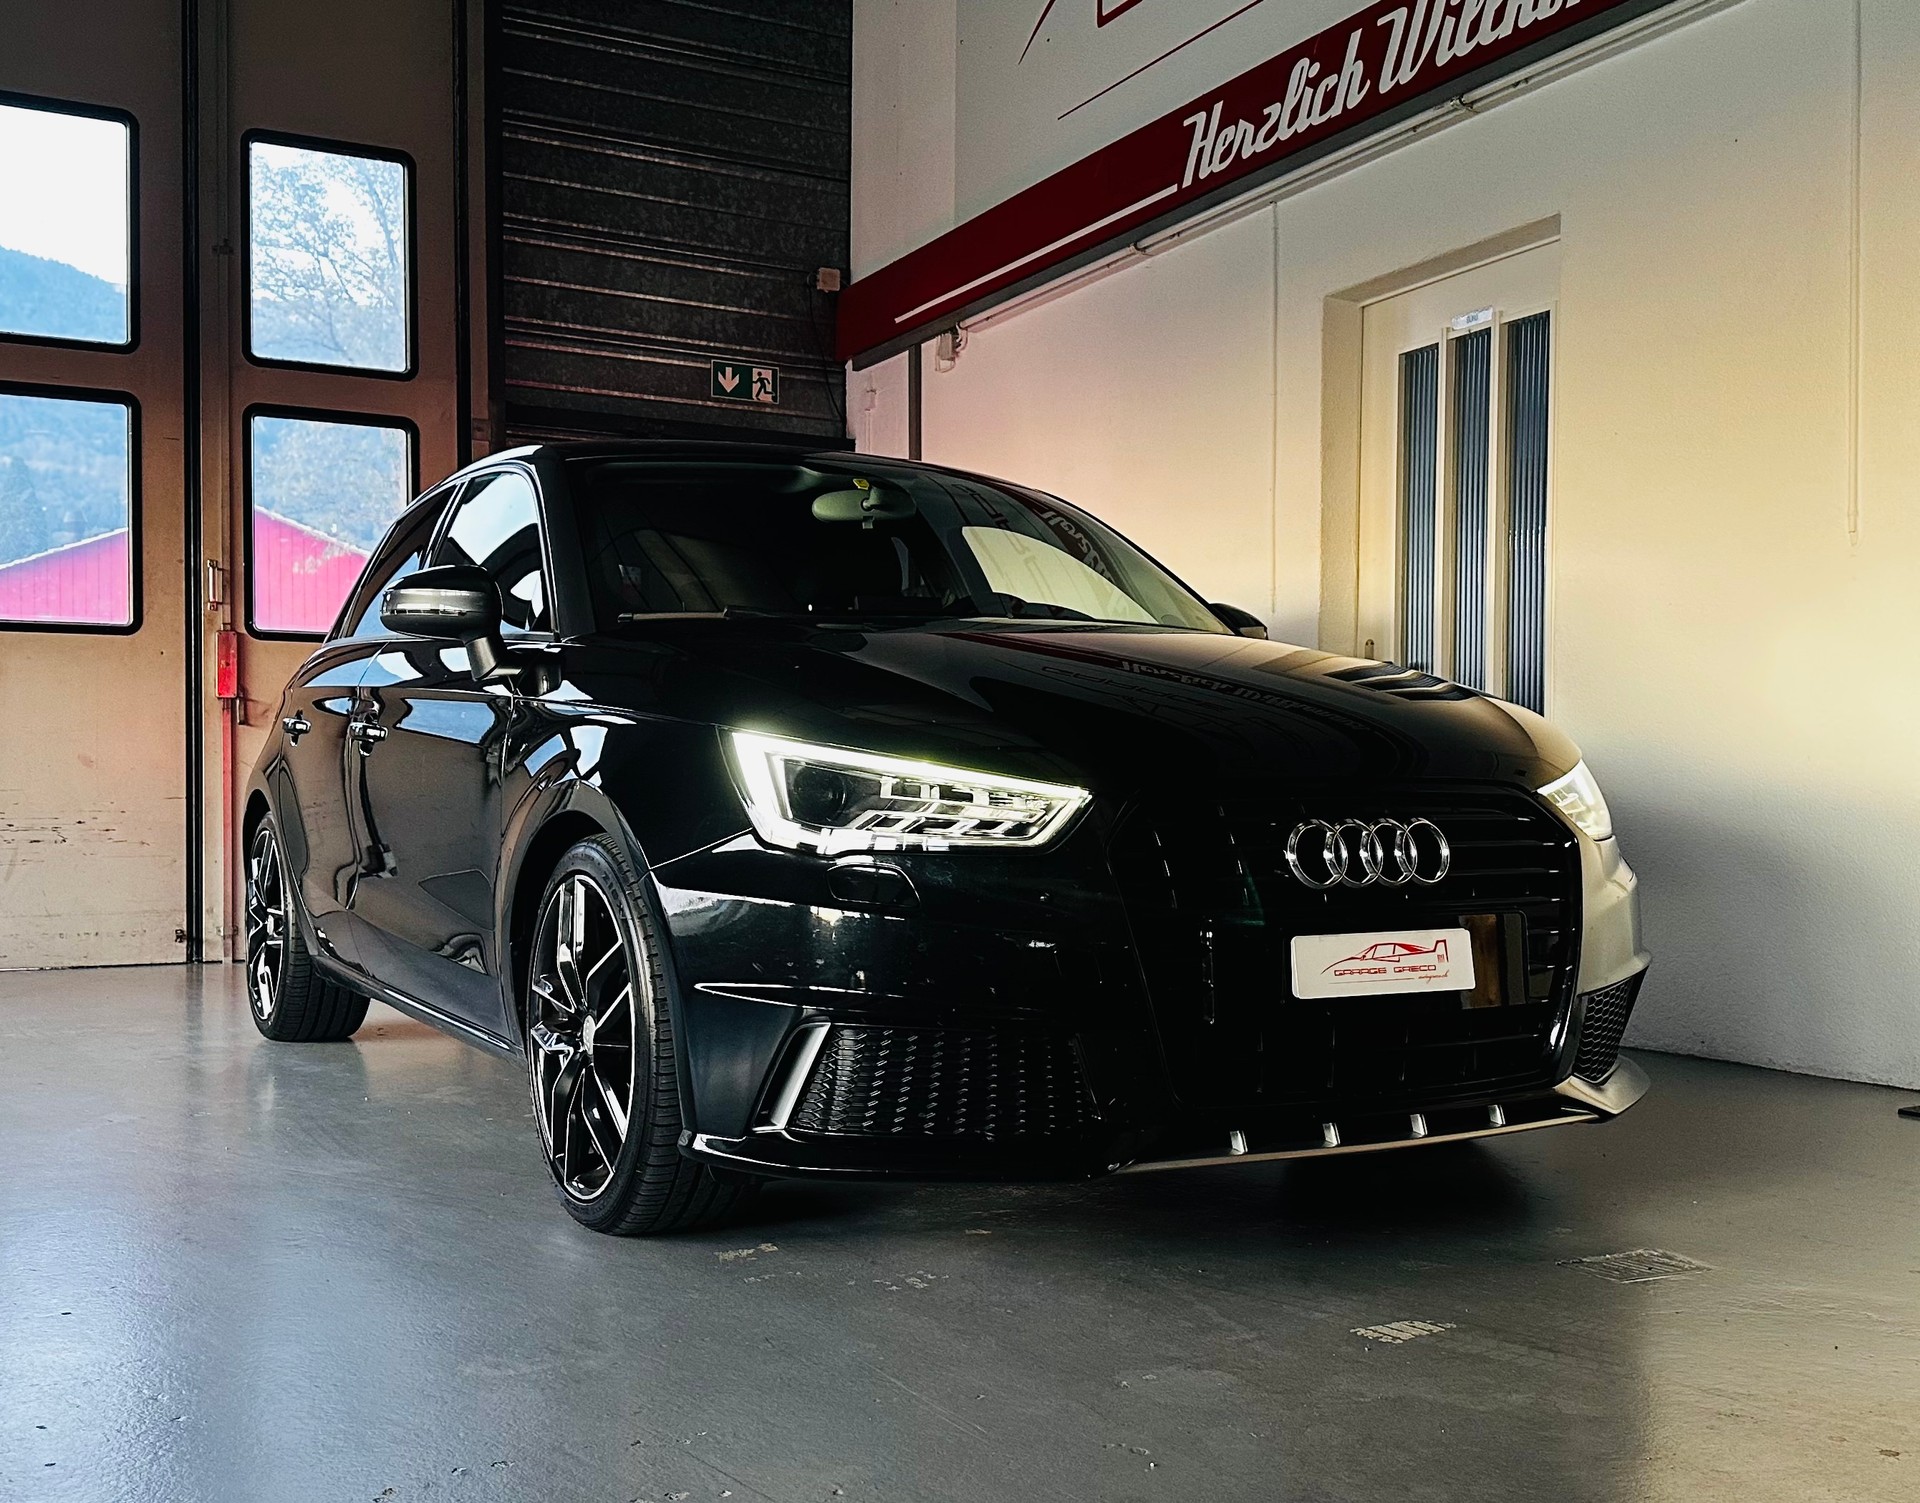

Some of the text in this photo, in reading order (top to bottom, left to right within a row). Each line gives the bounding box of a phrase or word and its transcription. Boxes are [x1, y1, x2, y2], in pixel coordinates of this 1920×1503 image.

[1183, 28, 1370, 188] Herzlich
[1334, 965, 1436, 976] GARAGE GRECO
